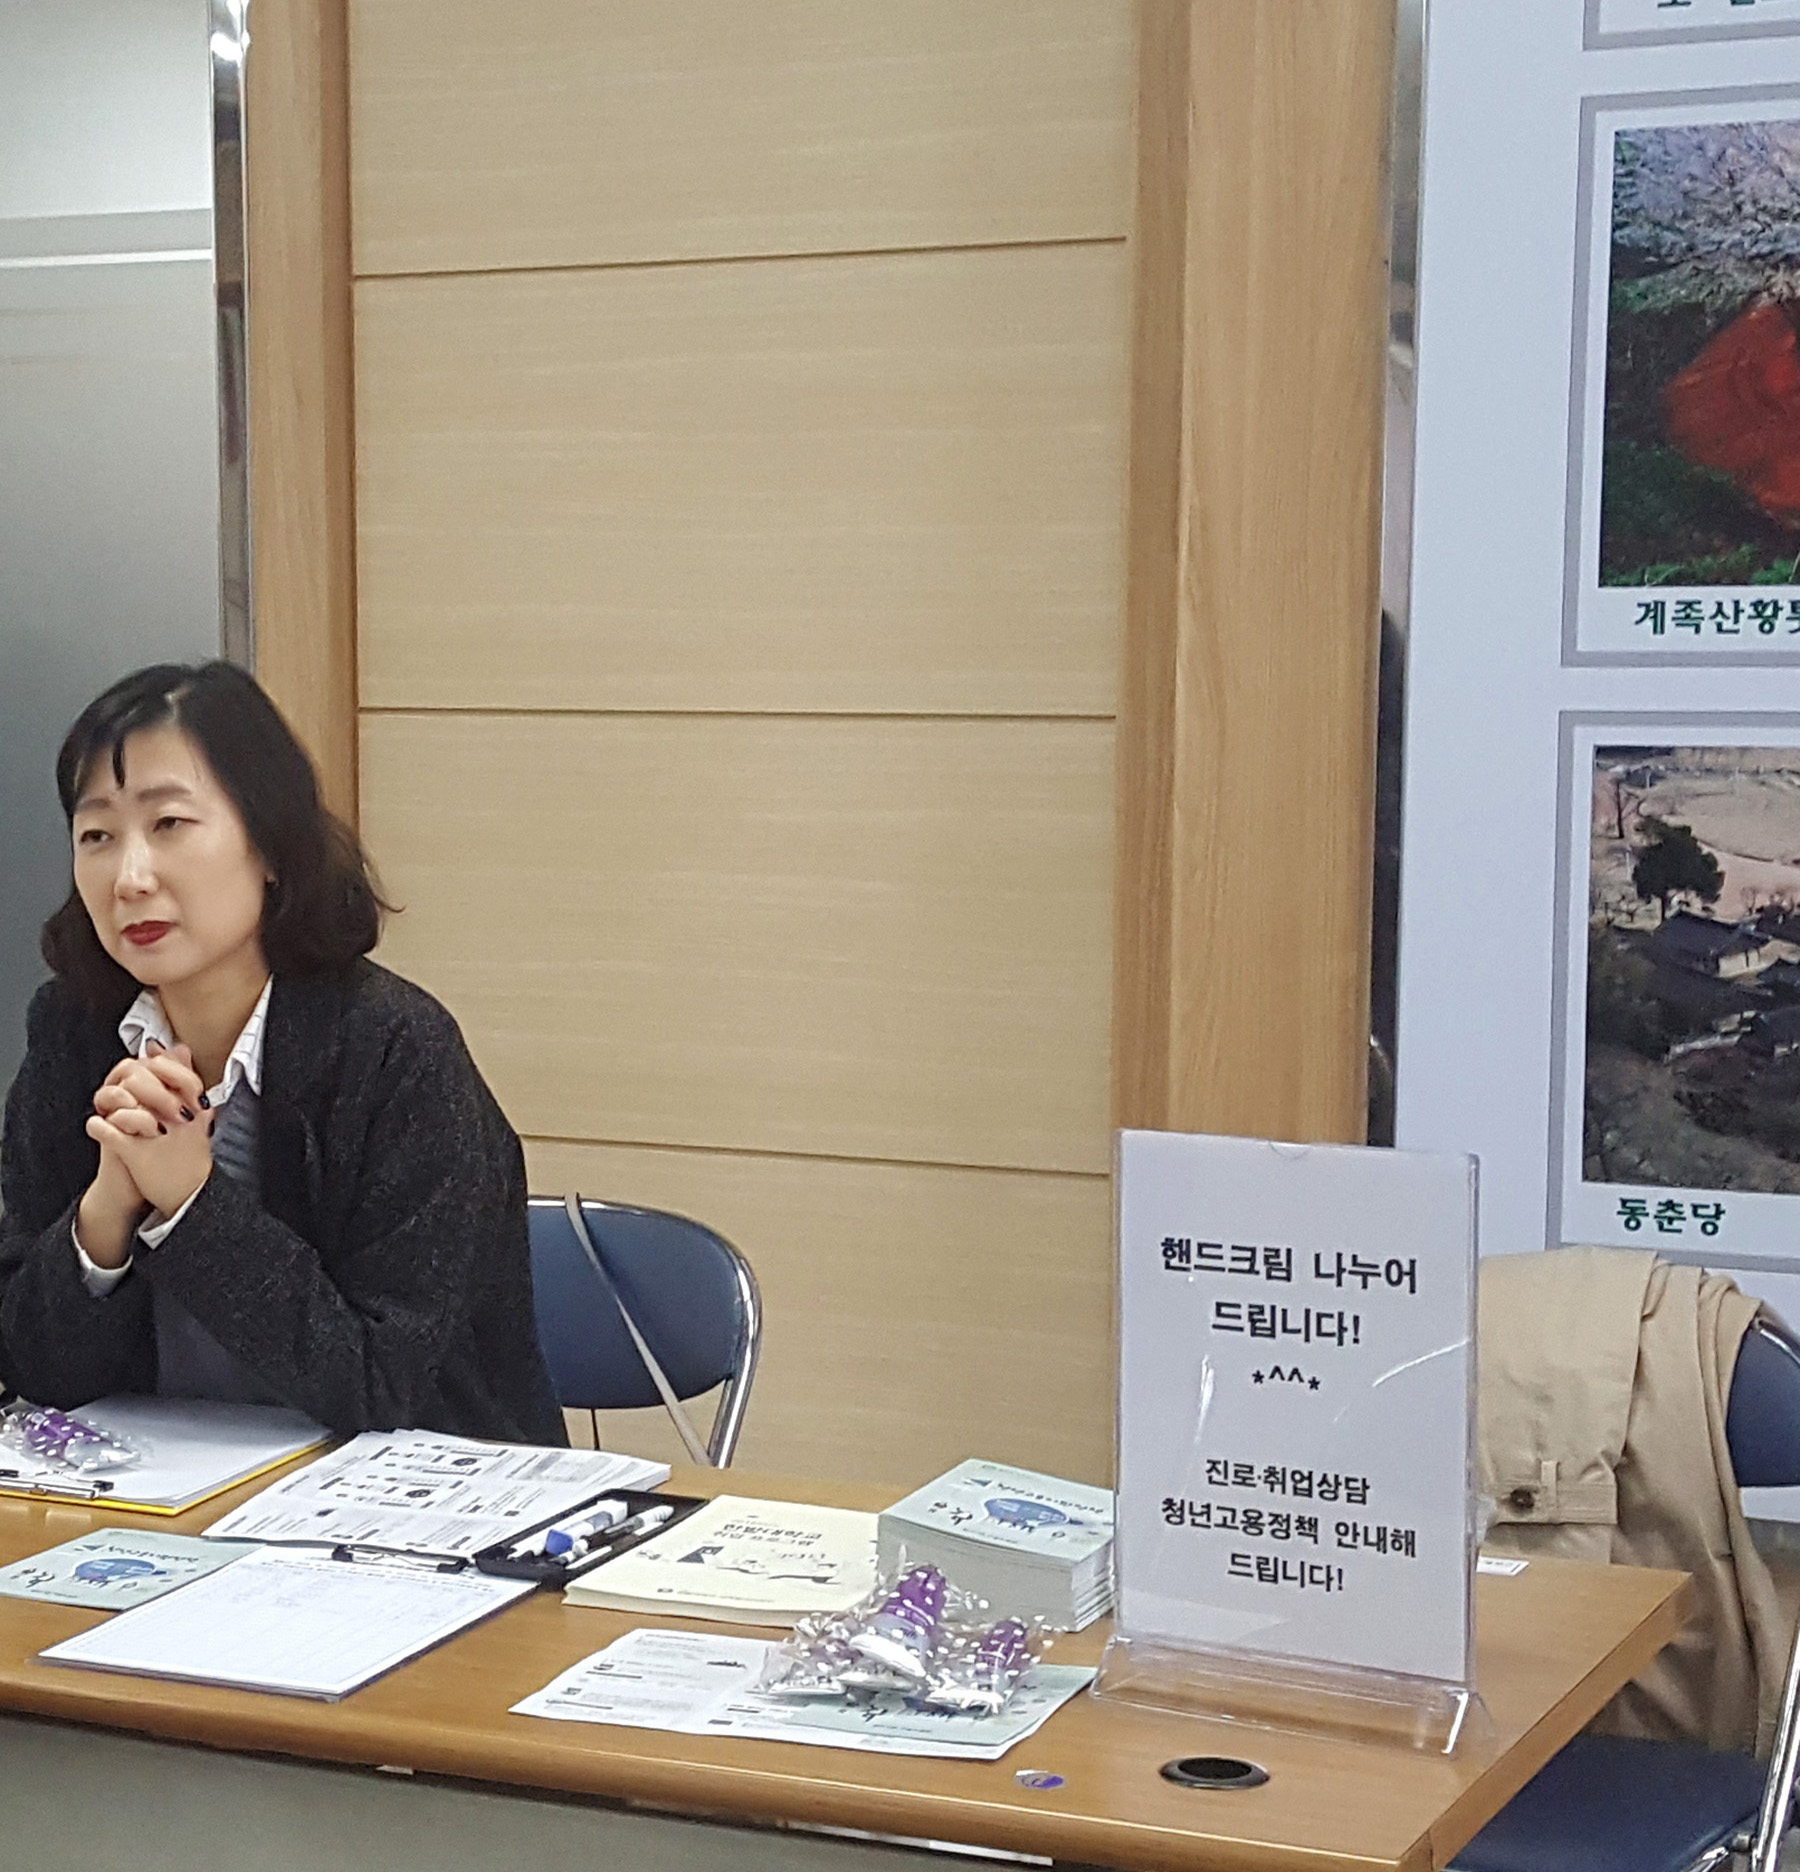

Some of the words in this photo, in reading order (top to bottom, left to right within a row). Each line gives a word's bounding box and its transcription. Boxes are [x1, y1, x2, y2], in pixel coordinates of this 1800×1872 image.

[1617, 1198, 1725, 1236] 동춘당
[1161, 1237, 1292, 1282] 핸드크림
[1314, 1252, 1416, 1294] 나누어
[1212, 1302, 1360, 1346] 드립니다!
[1161, 1498, 1320, 1543] 청년고용정책
[1335, 1522, 1416, 1558] 안내해
[1228, 1553, 1343, 1592] 드립니다!
